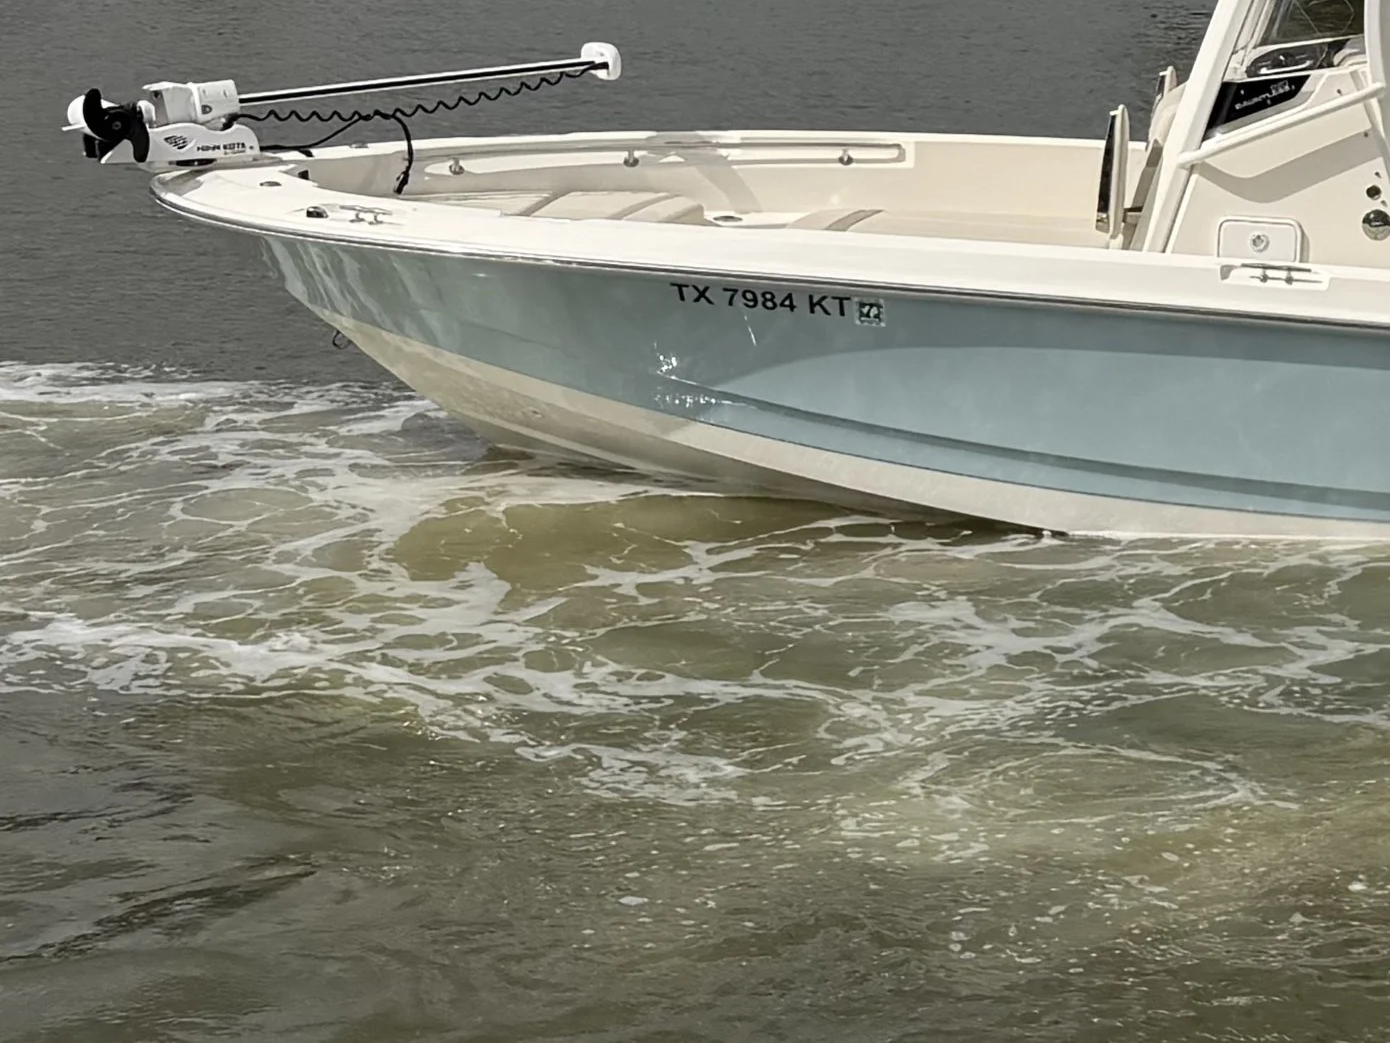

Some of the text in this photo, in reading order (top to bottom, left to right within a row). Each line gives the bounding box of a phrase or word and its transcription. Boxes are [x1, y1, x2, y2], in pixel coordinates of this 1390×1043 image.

[669, 282, 716, 306] TX
[721, 287, 798, 313] 7984
[807, 294, 851, 318] KT
